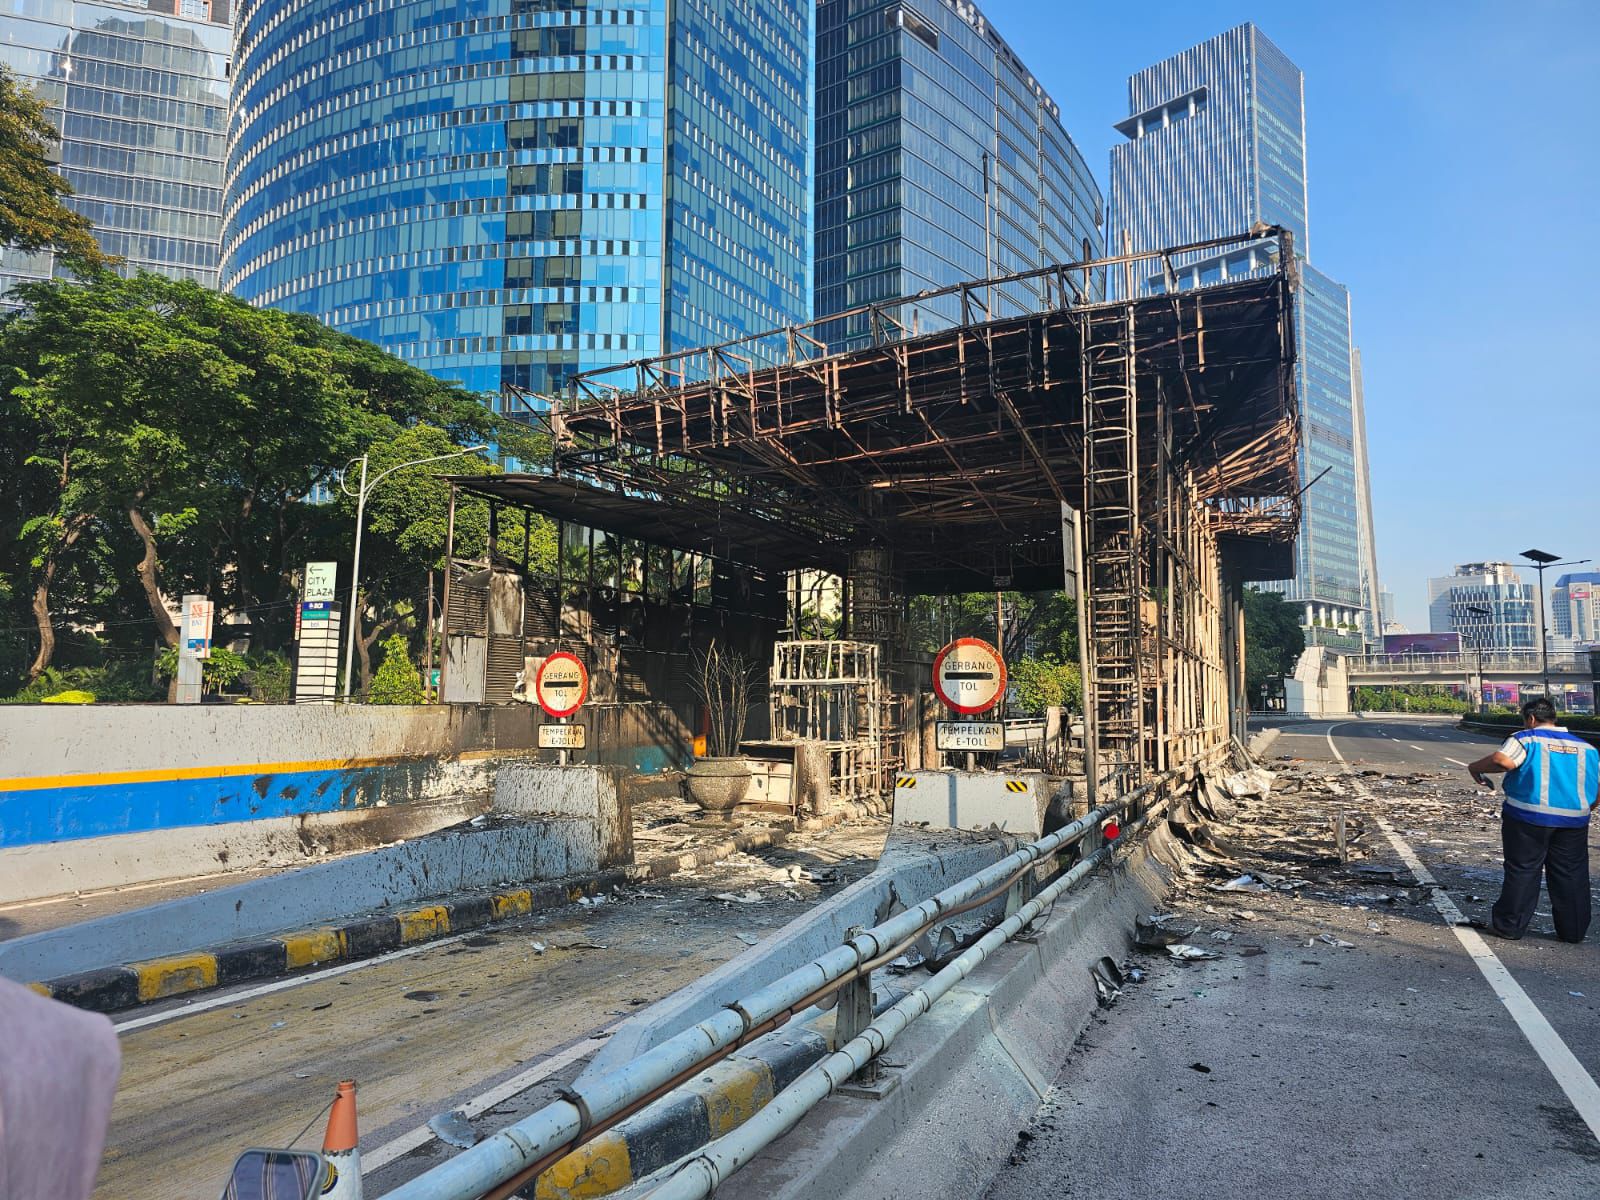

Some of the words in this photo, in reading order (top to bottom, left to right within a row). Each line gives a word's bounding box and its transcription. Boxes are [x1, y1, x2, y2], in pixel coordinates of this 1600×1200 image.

[307, 576, 327, 585] CITY
[306, 588, 334, 597] PLAZA
[945, 661, 993, 671] GERBANG
[543, 672, 579, 680] GERBANG
[960, 681, 979, 691] TOL
[554, 689, 567, 697] TOL
[542, 728, 582, 736] TEMPELKAN
[942, 726, 999, 736] TEMPELKAN
[551, 737, 575, 745] E-TOLL
[956, 737, 989, 746] E-TOLL
